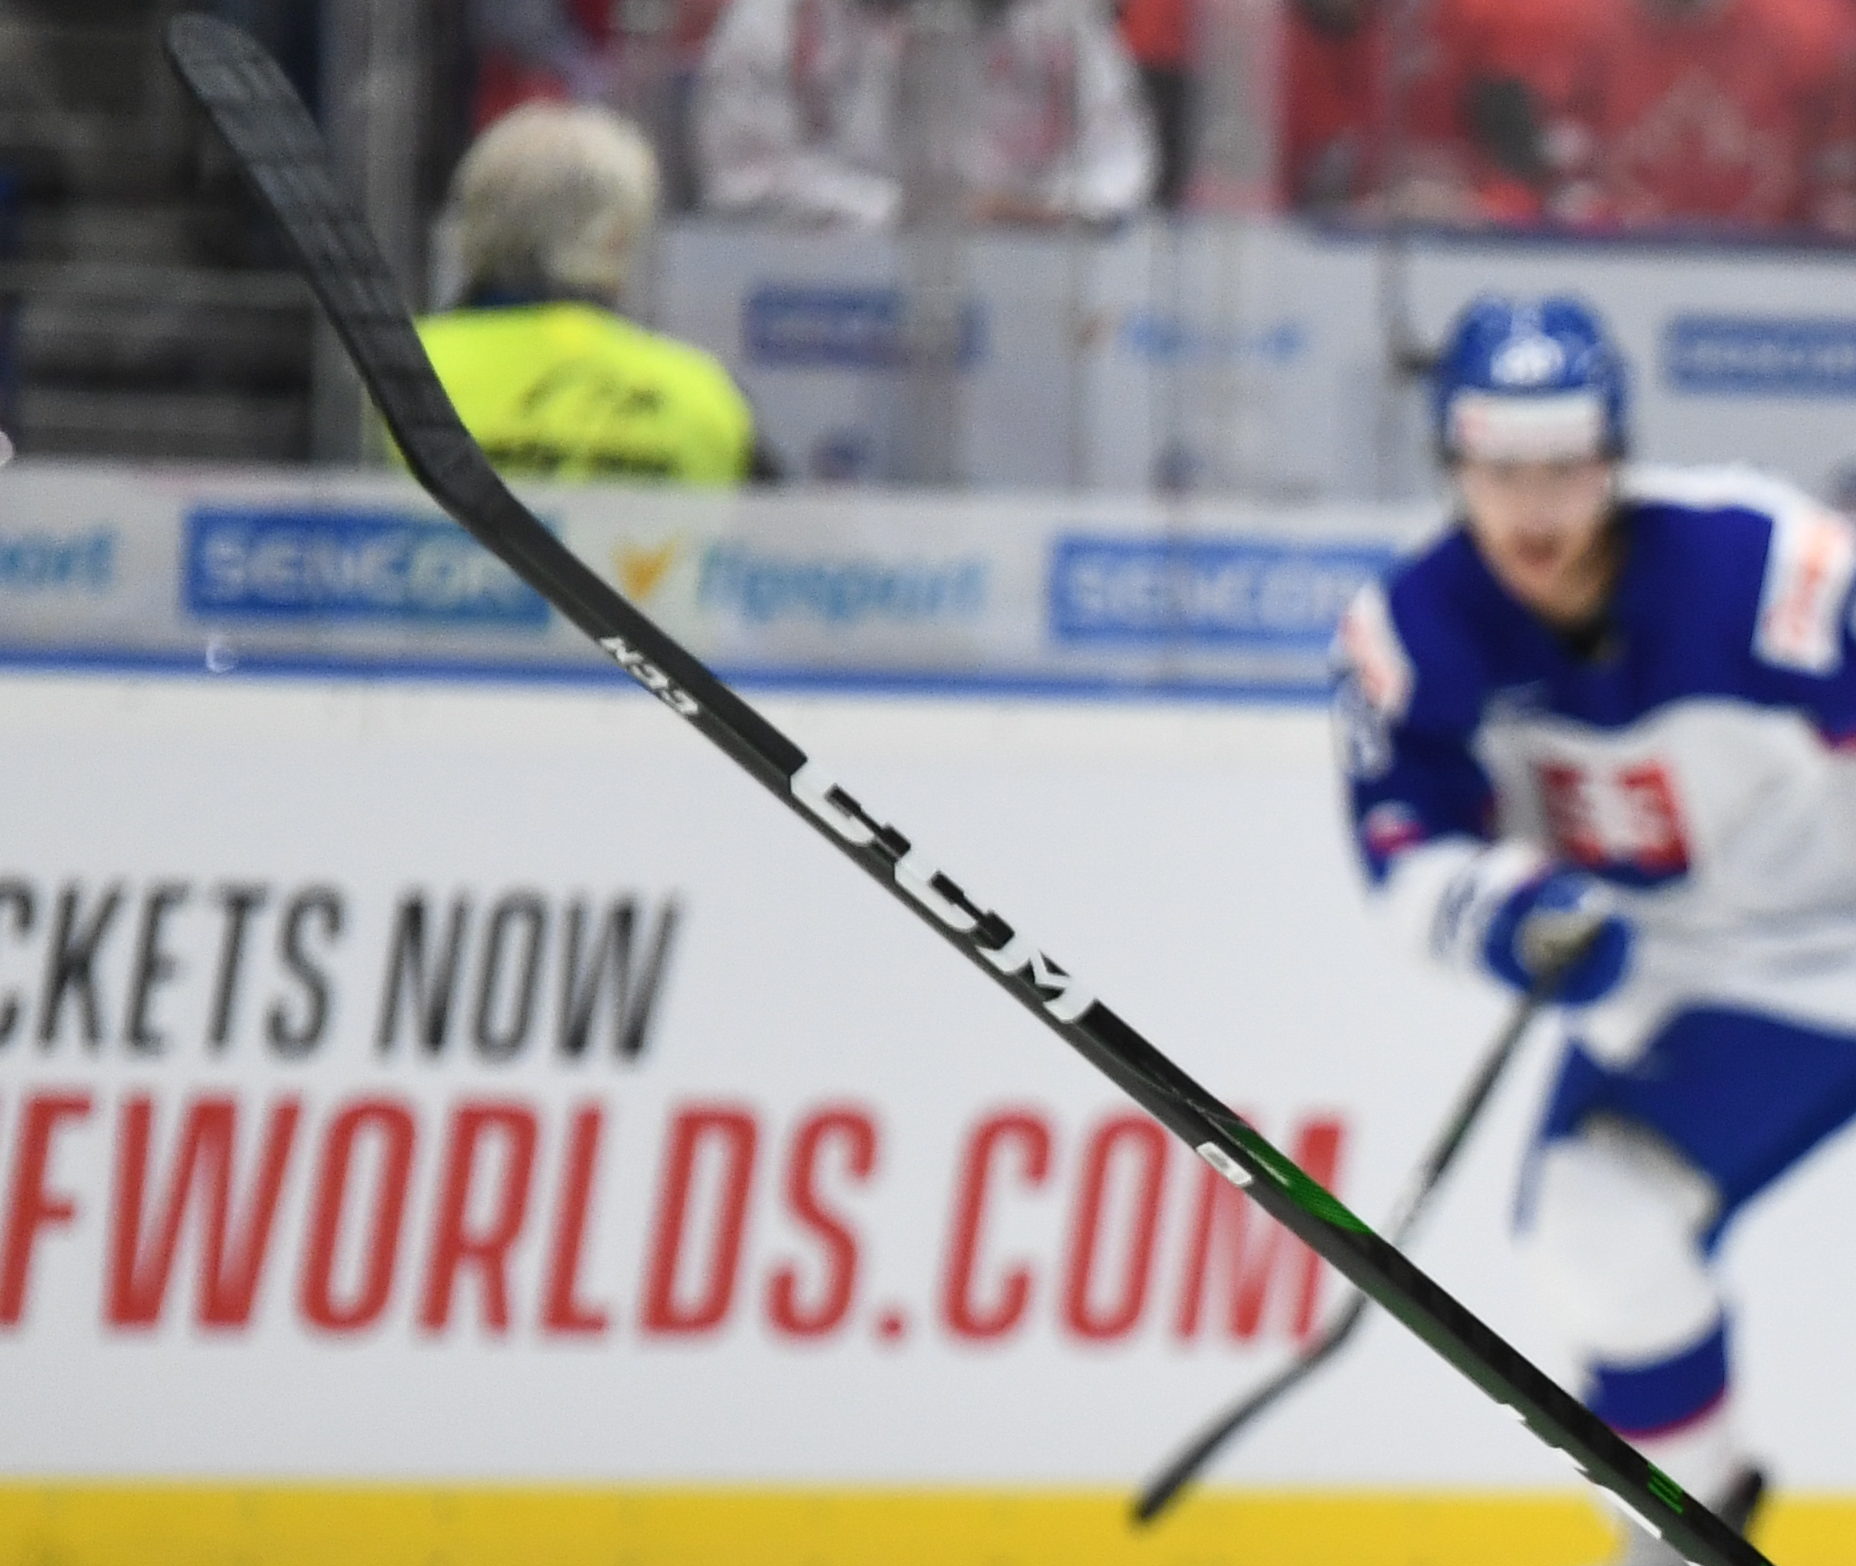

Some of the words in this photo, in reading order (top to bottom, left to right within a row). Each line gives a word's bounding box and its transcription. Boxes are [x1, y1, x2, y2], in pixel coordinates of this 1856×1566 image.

[376, 888, 686, 1064] NOW
[791, 764, 1096, 1022] CCM
[0, 1094, 1345, 1345] FWORLDS.COM
